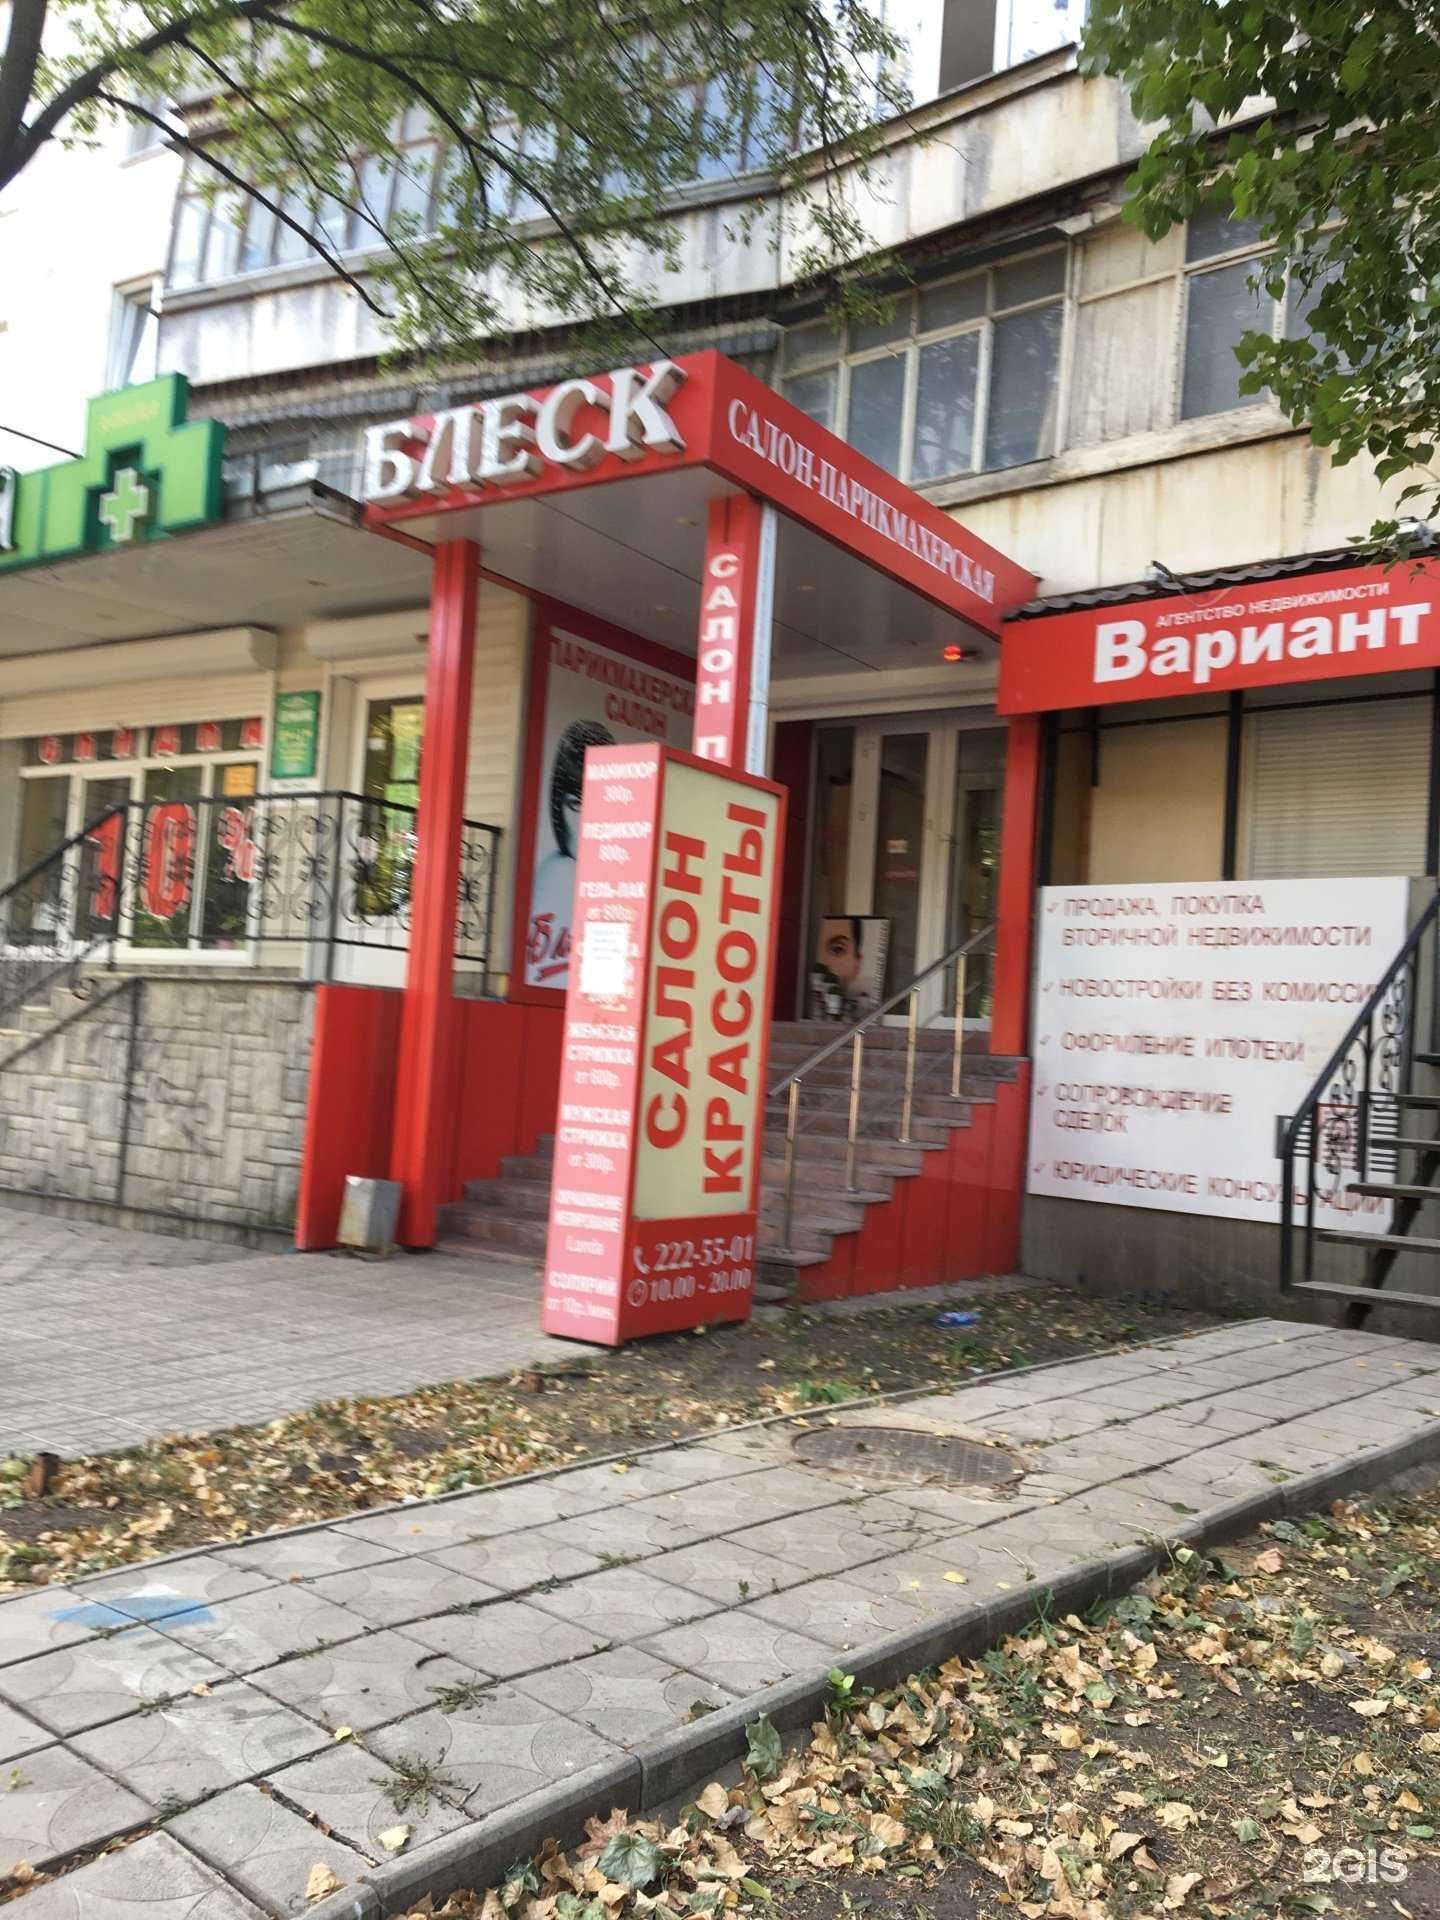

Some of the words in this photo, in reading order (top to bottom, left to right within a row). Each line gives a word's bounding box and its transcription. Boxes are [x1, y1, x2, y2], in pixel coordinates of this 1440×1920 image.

[364, 360, 688, 504] БЛЕСК
[728, 399, 995, 605] САЛОН-ПАРИКМАХЕРСКАЯ
[1156, 603, 1245, 629] АГЕНТСТВО
[1248, 582, 1389, 616] НЕДВИЖИМОСТИ
[700, 553, 739, 705] САЛОН
[1093, 602, 1431, 684] Вариант
[1169, 895, 1266, 915] ПОКУПКА
[1062, 923, 1178, 947] ВТОРИЧНОЙ
[1187, 925, 1372, 949] НЕДВИЖИМОСТИ
[645, 831, 707, 1149] САЛОН
[702, 802, 768, 1193] КРАСОТЫ
[1059, 976, 1202, 1000] НОВОСТРОЙКИ
[1212, 980, 1252, 1001] БЕЗ
[1262, 981, 1378, 1003] КОМИССИ
[1060, 1031, 1196, 1057] ОФОРМЛЕНИЕ
[1204, 1036, 1306, 1062] ИПОТЕКИ
[1054, 1081, 1234, 1114] СОПРОВОЖДЕНИЕ
[1053, 1108, 1129, 1132] СДЕЛОК
[1053, 1160, 1201, 1194] ЮРИДИЧЕСКИЕ
[653, 1234, 753, 1272] 222-55-01
